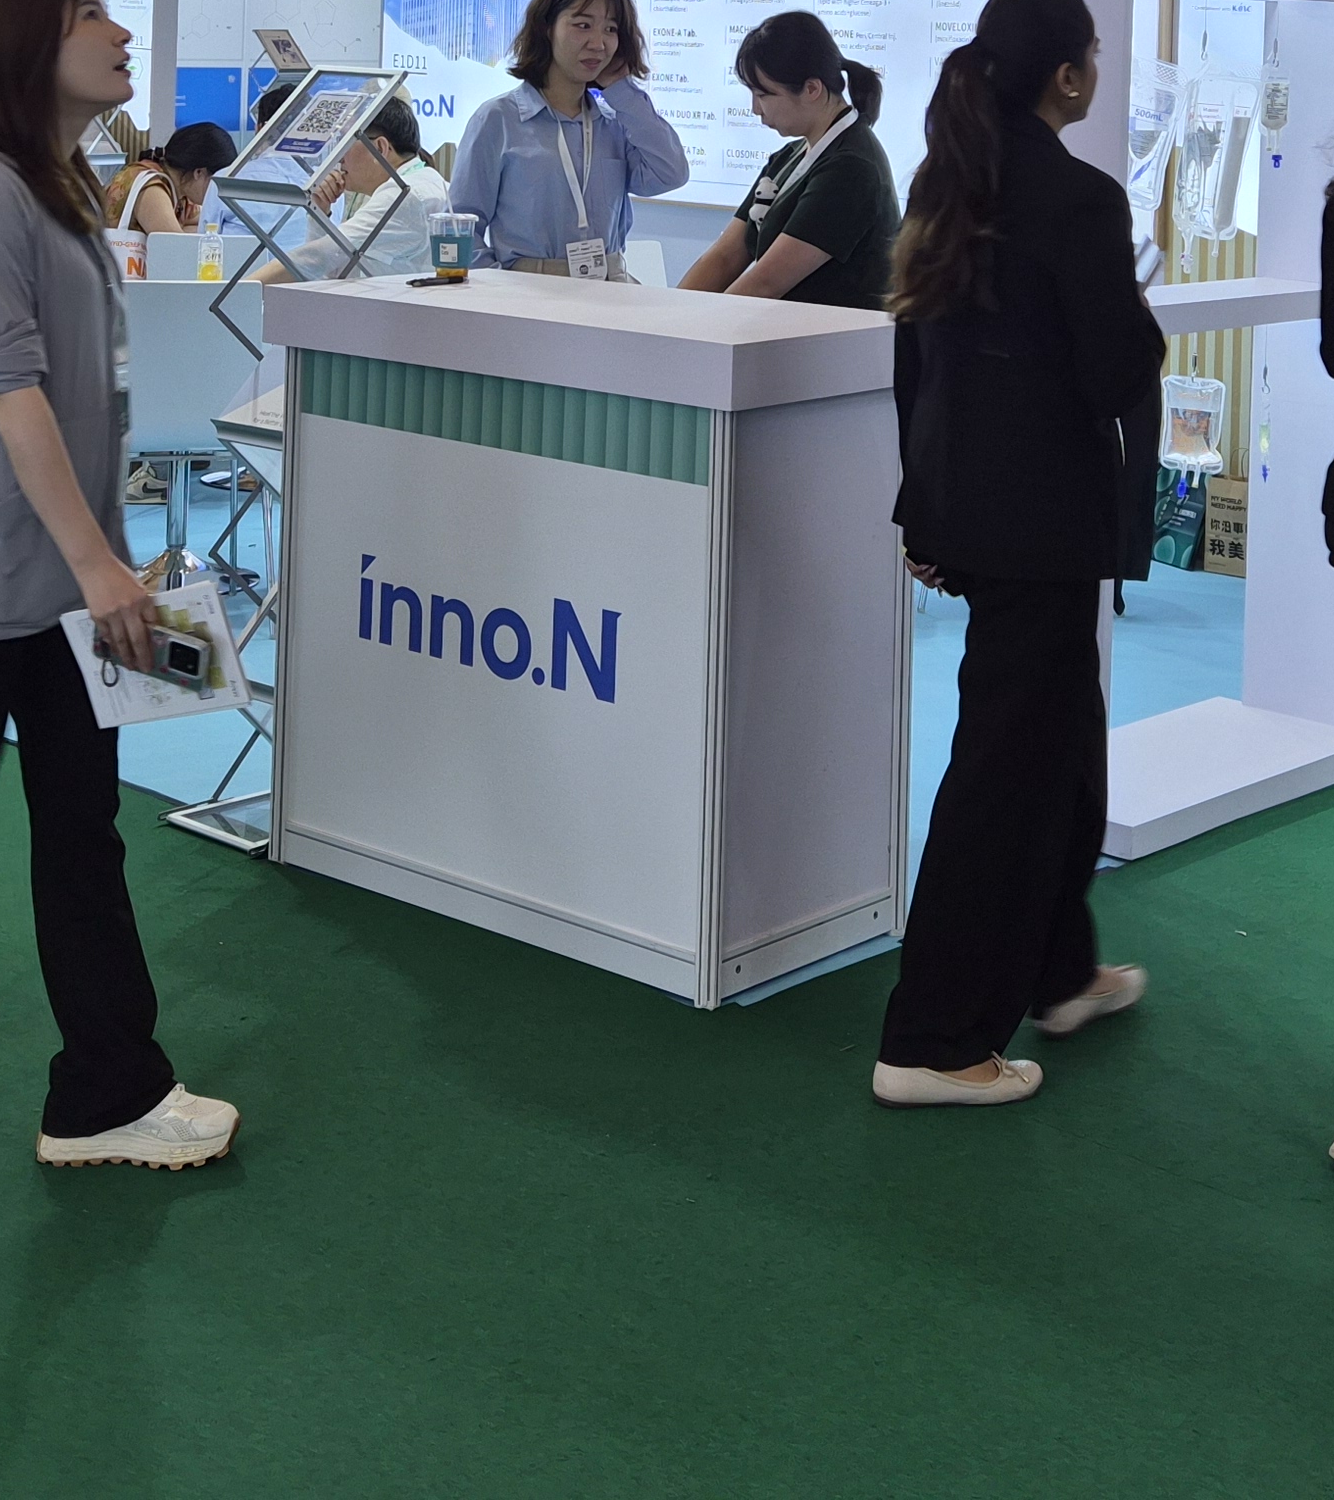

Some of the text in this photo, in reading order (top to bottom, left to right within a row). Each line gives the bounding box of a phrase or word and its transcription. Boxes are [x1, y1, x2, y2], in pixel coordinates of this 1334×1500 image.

[935, 22, 977, 32] MOVELOXI
[653, 28, 698, 38] EXONE-A Tab.
[392, 53, 427, 70] E1D11
[652, 74, 689, 83] EXONE Tab.
[676, 110, 691, 119] DUO
[702, 111, 717, 120] Tab.
[1134, 108, 1163, 123] 500mL
[727, 149, 759, 159] CLOSONE
[359, 553, 623, 705] inno.N
